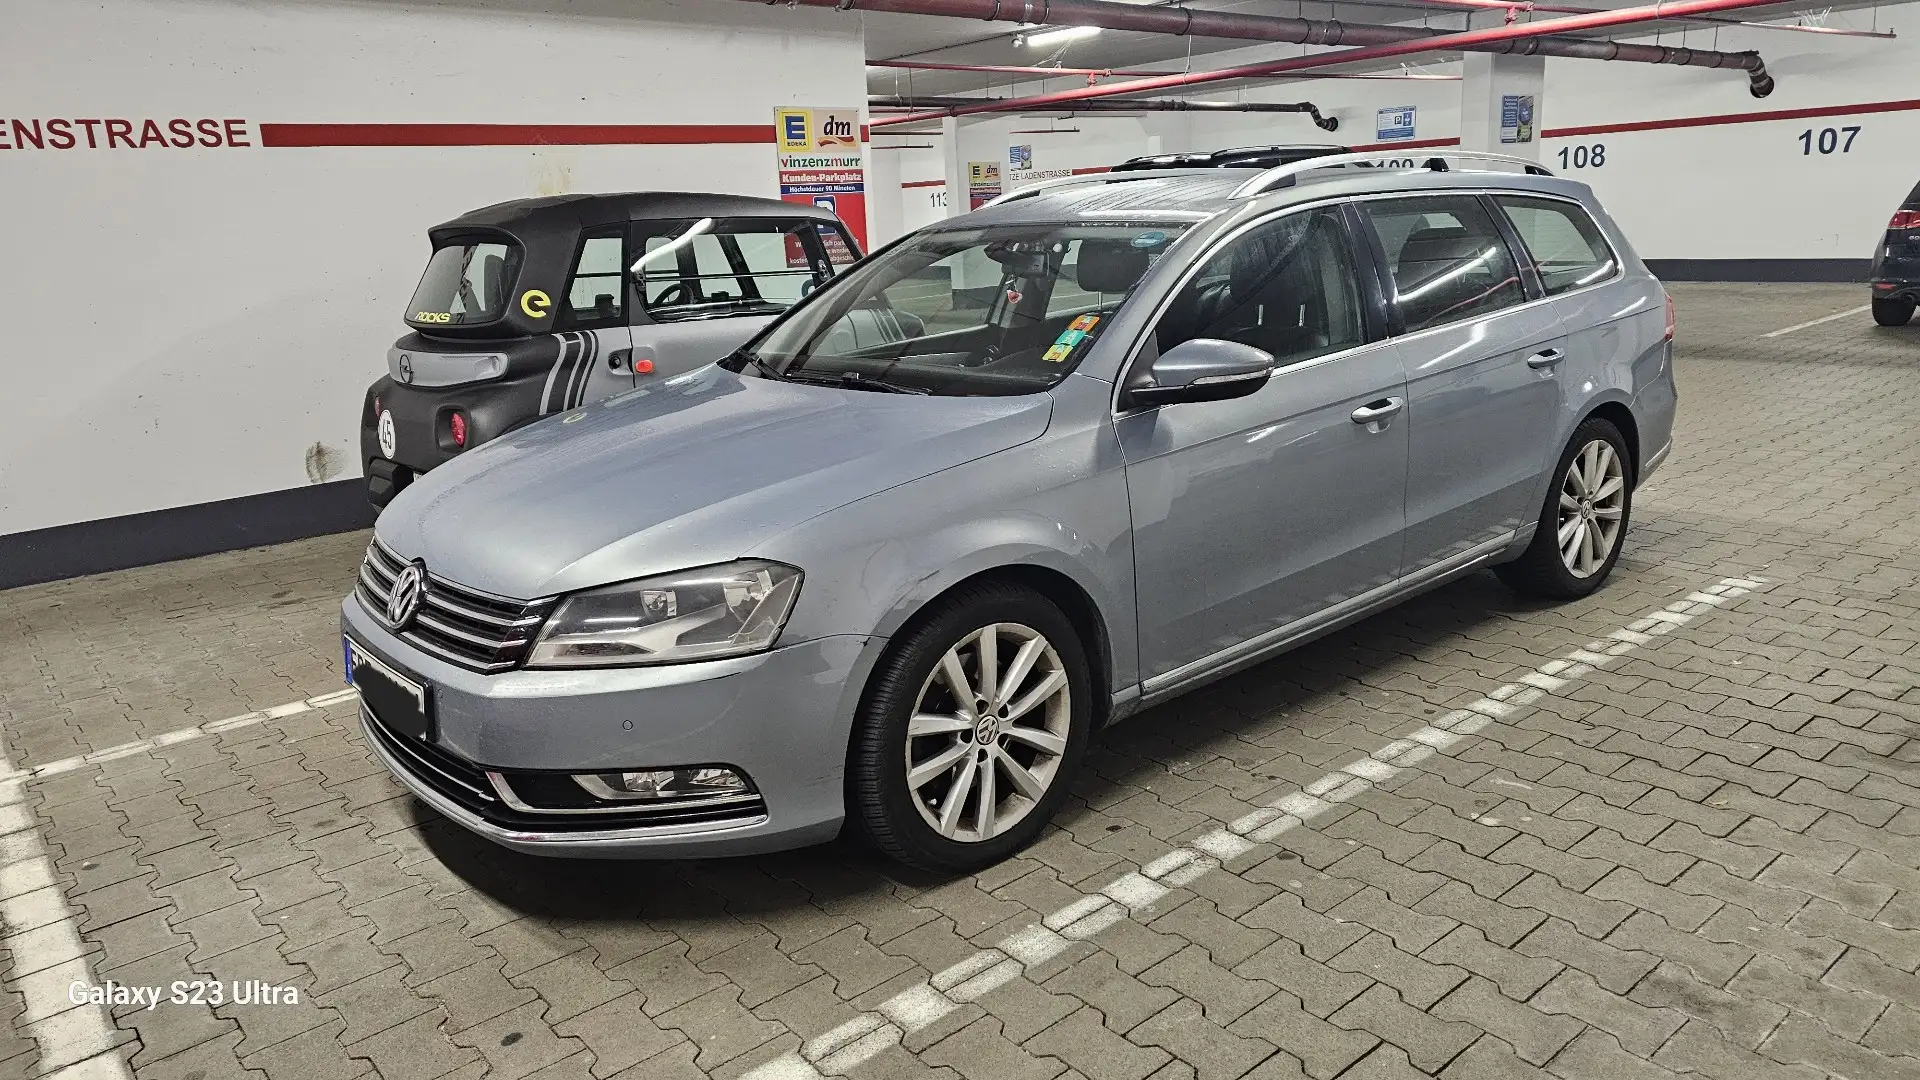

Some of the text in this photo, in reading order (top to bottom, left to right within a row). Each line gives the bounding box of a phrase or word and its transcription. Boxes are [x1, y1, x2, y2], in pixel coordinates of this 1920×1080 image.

[823, 115, 851, 136] dm
[1798, 126, 1862, 155] 107
[781, 155, 860, 168] vinzenzmurr
[1557, 143, 1606, 169] 108
[782, 173, 862, 183] Kunden-Parkplatz
[1021, 169, 1071, 180] LADENSTRASSE
[415, 311, 452, 323] ROCKS
[382, 418, 392, 450] 45
